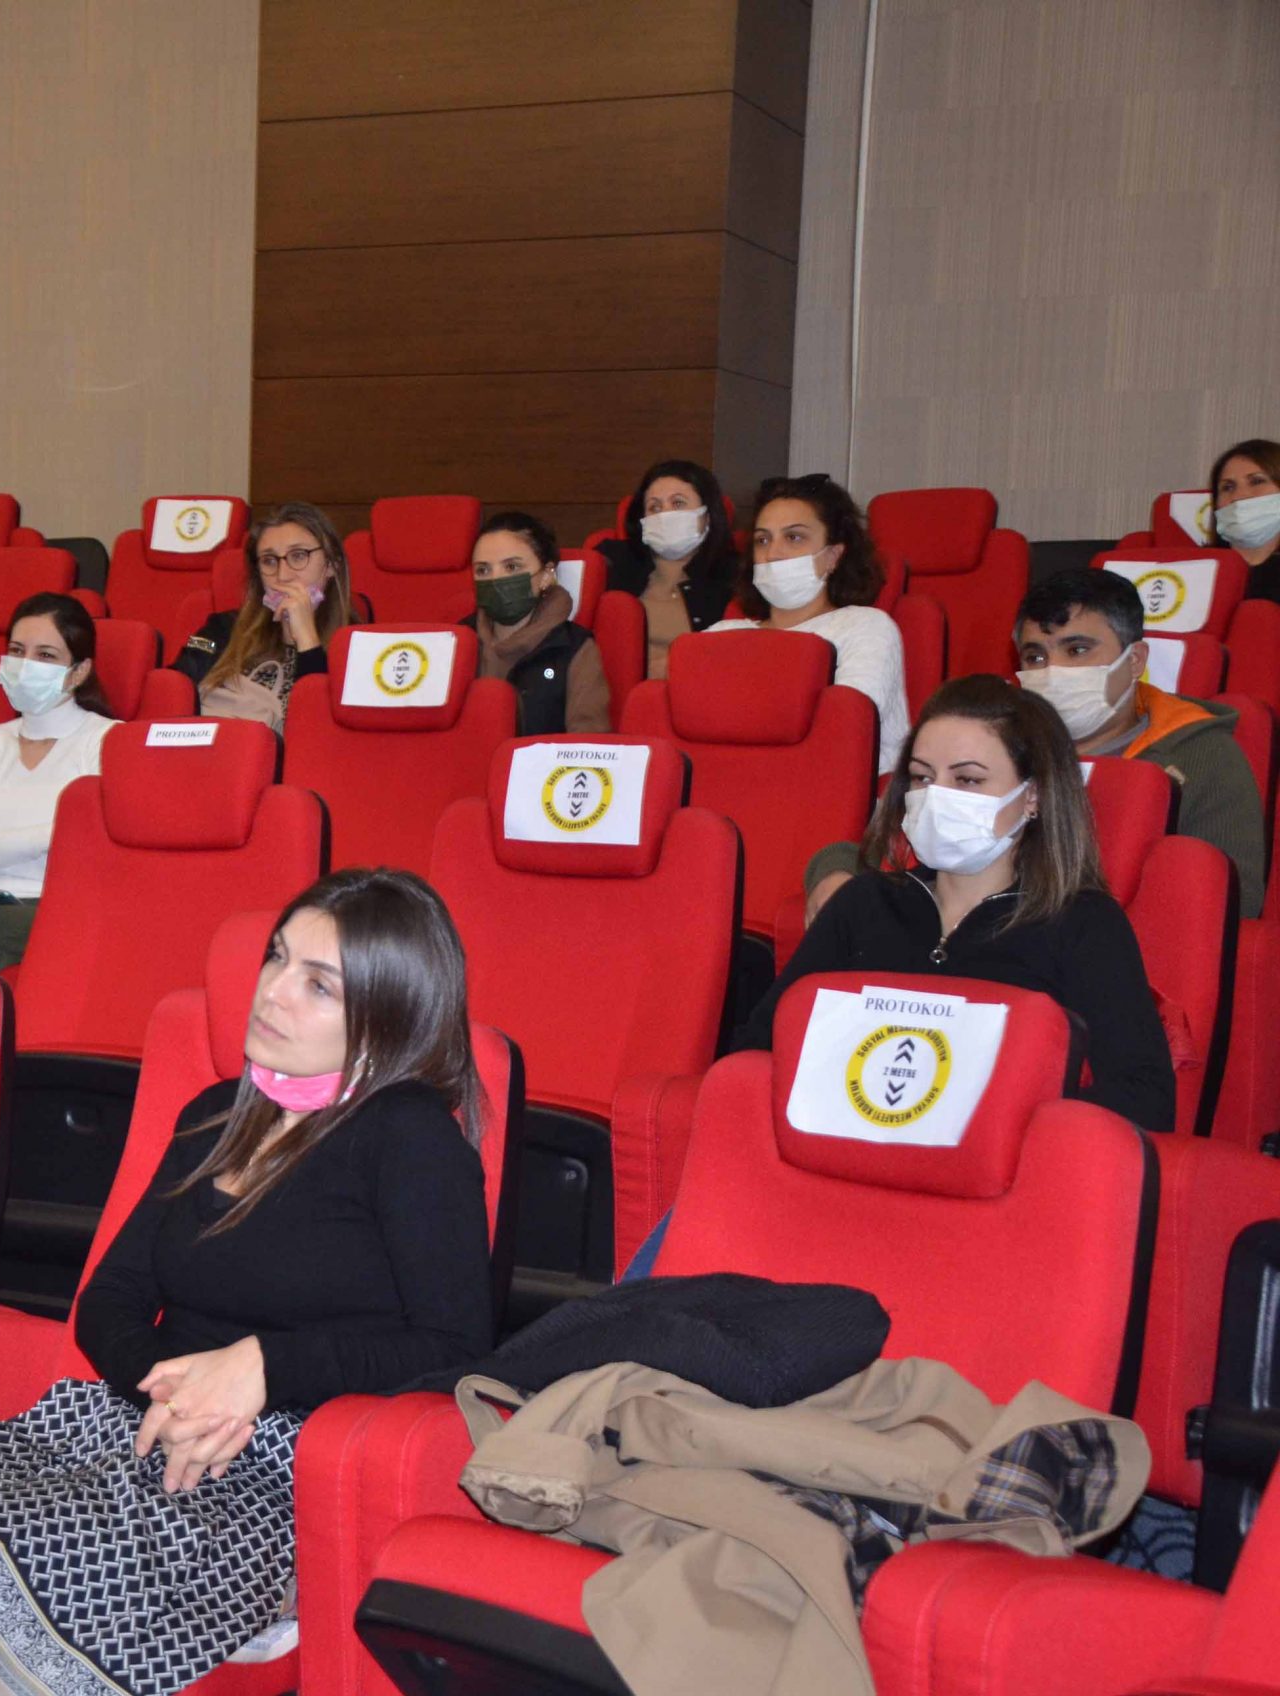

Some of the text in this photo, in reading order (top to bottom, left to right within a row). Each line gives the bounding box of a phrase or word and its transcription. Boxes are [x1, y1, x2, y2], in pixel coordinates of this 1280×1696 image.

[155, 730, 212, 738] PROTOKOL
[556, 750, 618, 761] PROTOKOL
[864, 997, 955, 1018] PROTOKOL
[856, 1031, 885, 1057] SOSYAL
[883, 1067, 917, 1079] 2 METRE
[913, 1087, 939, 1114] SOSYAL
